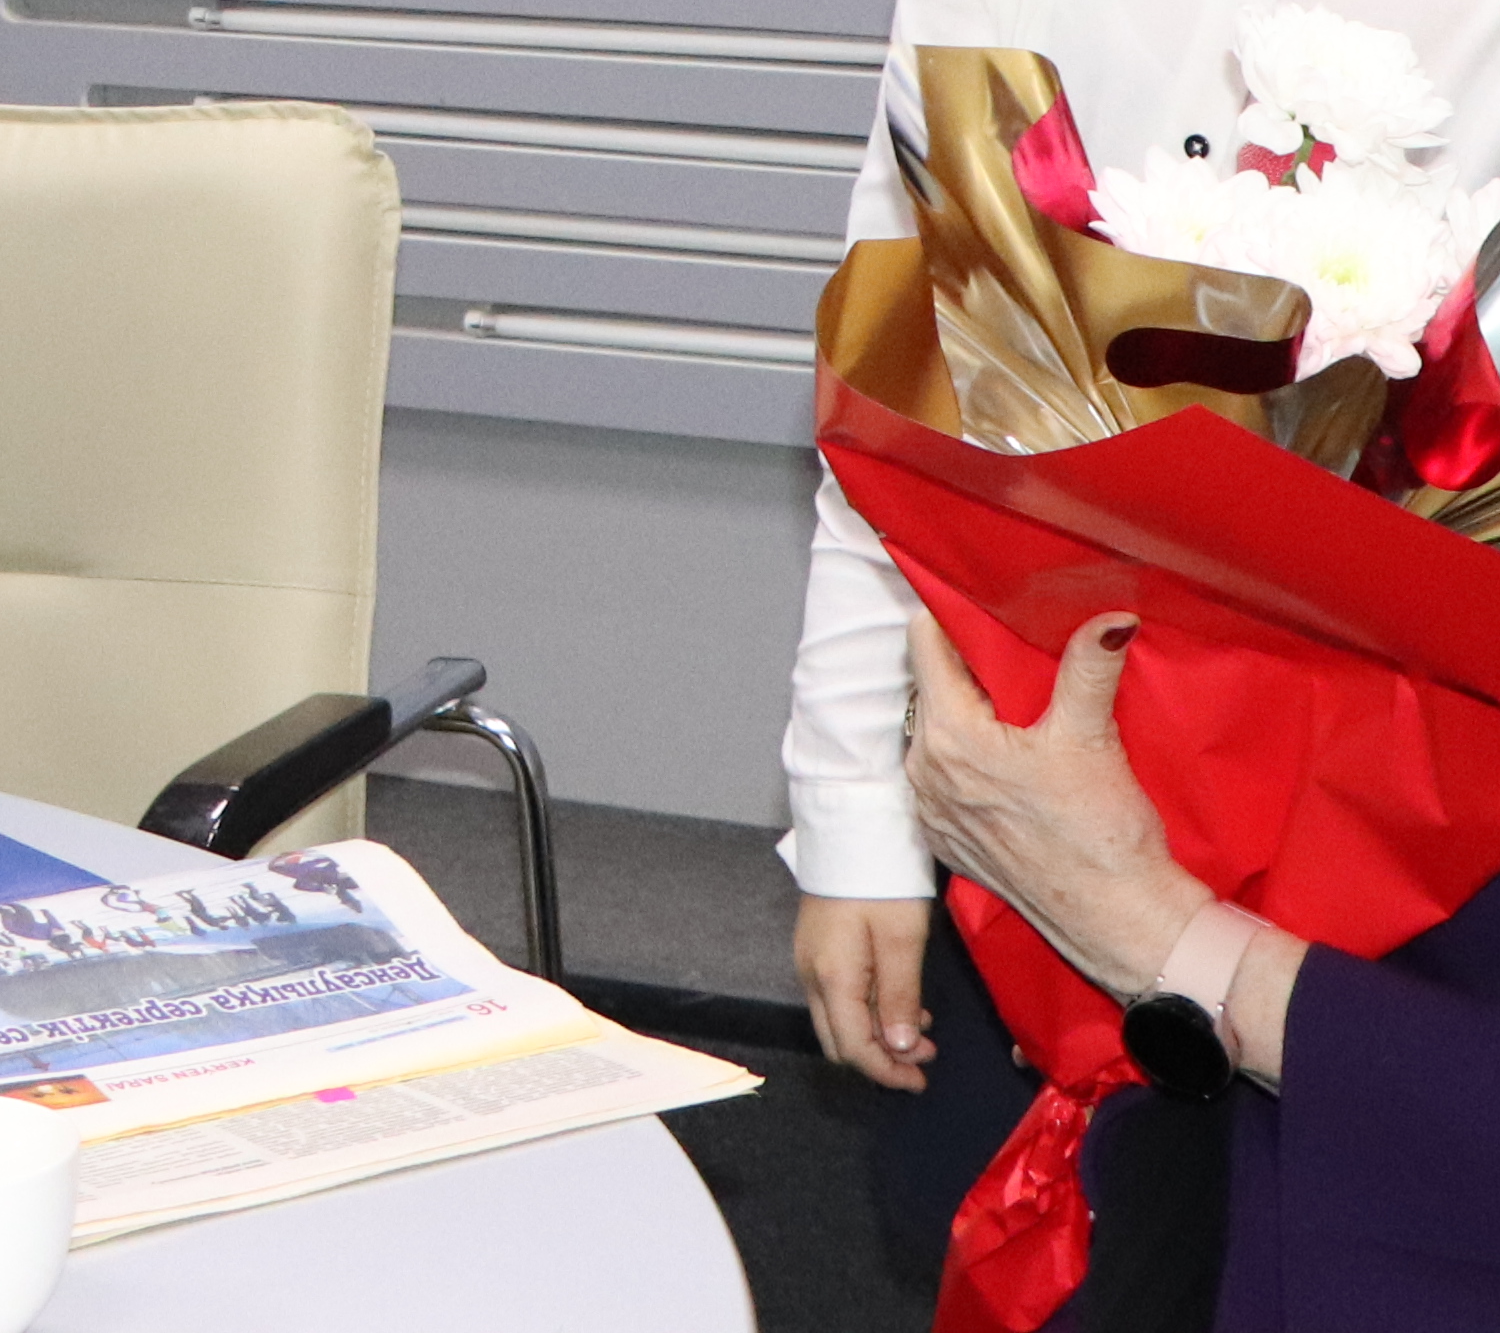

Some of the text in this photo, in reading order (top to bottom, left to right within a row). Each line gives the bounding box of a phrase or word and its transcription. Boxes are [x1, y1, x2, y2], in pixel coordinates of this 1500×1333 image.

[210, 959, 442, 1012] Денсаулыққа
[466, 999, 508, 1016] 16
[45, 997, 204, 1043] сергектік
